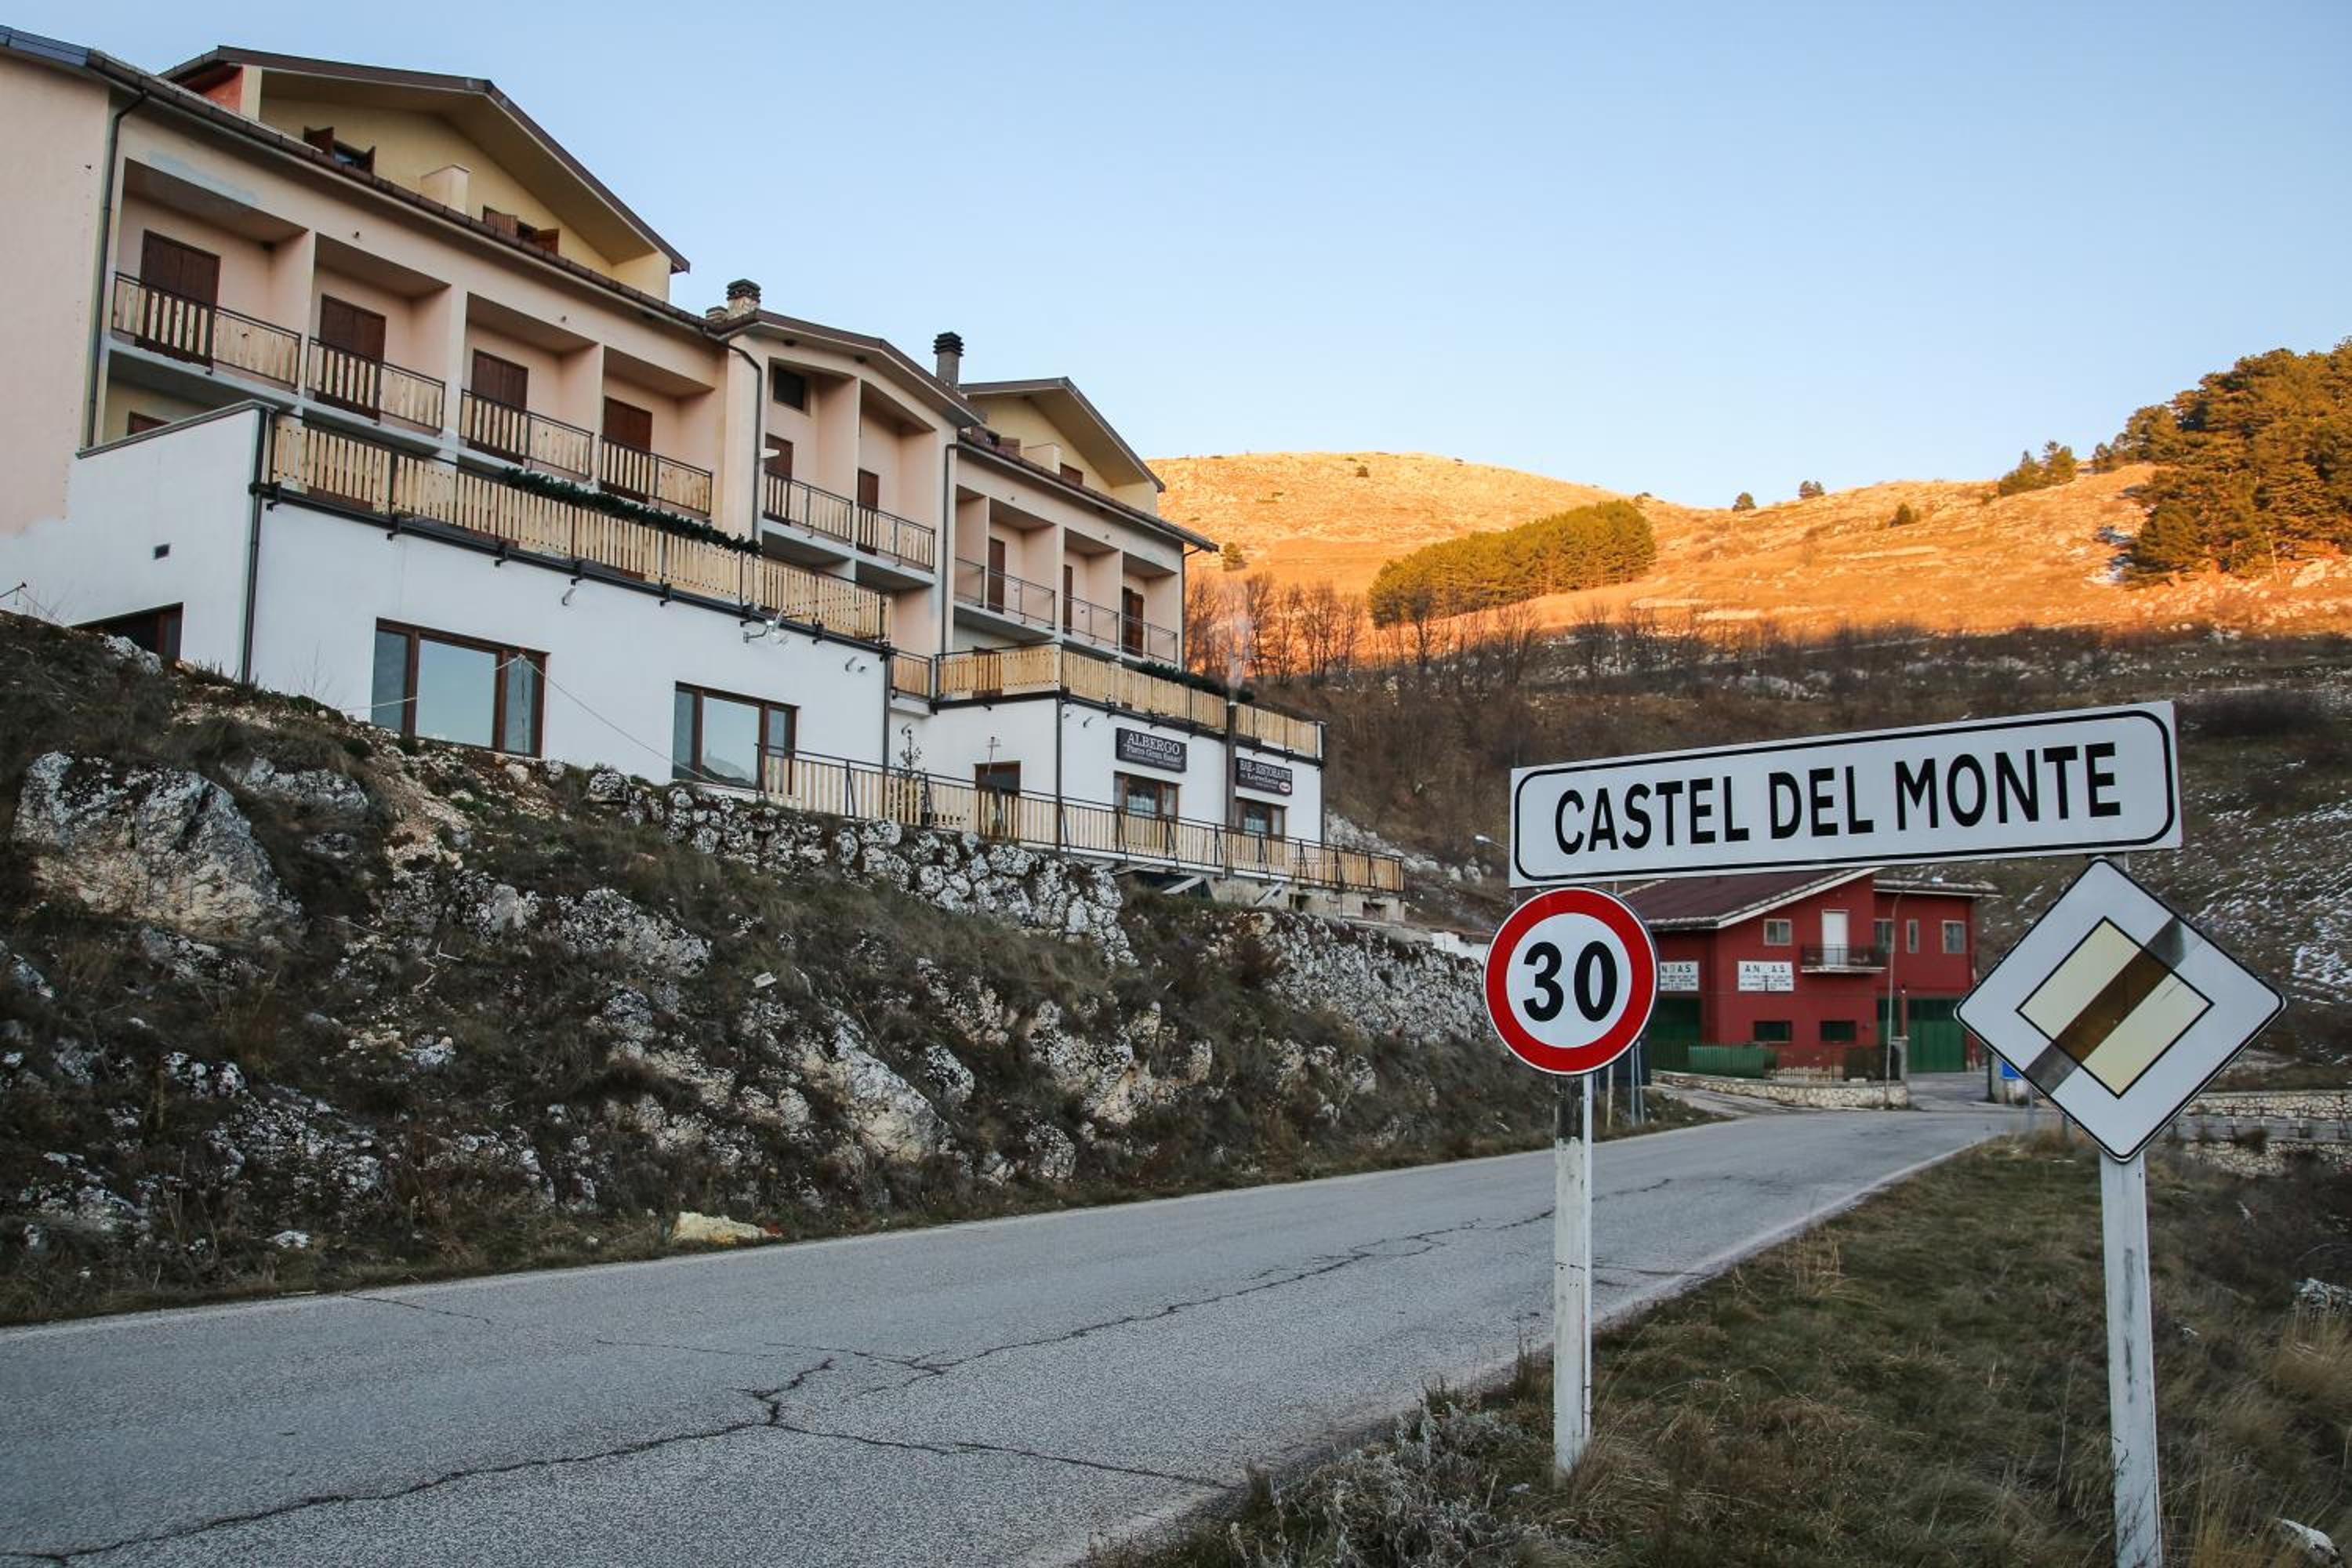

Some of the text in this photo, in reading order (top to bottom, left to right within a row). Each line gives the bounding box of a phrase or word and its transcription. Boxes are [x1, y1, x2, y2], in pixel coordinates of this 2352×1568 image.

[1127, 732, 1180, 755] ALBERGO
[1555, 742, 2122, 855] CASTEL DEL MONTE
[1523, 940, 1617, 1022] 30
